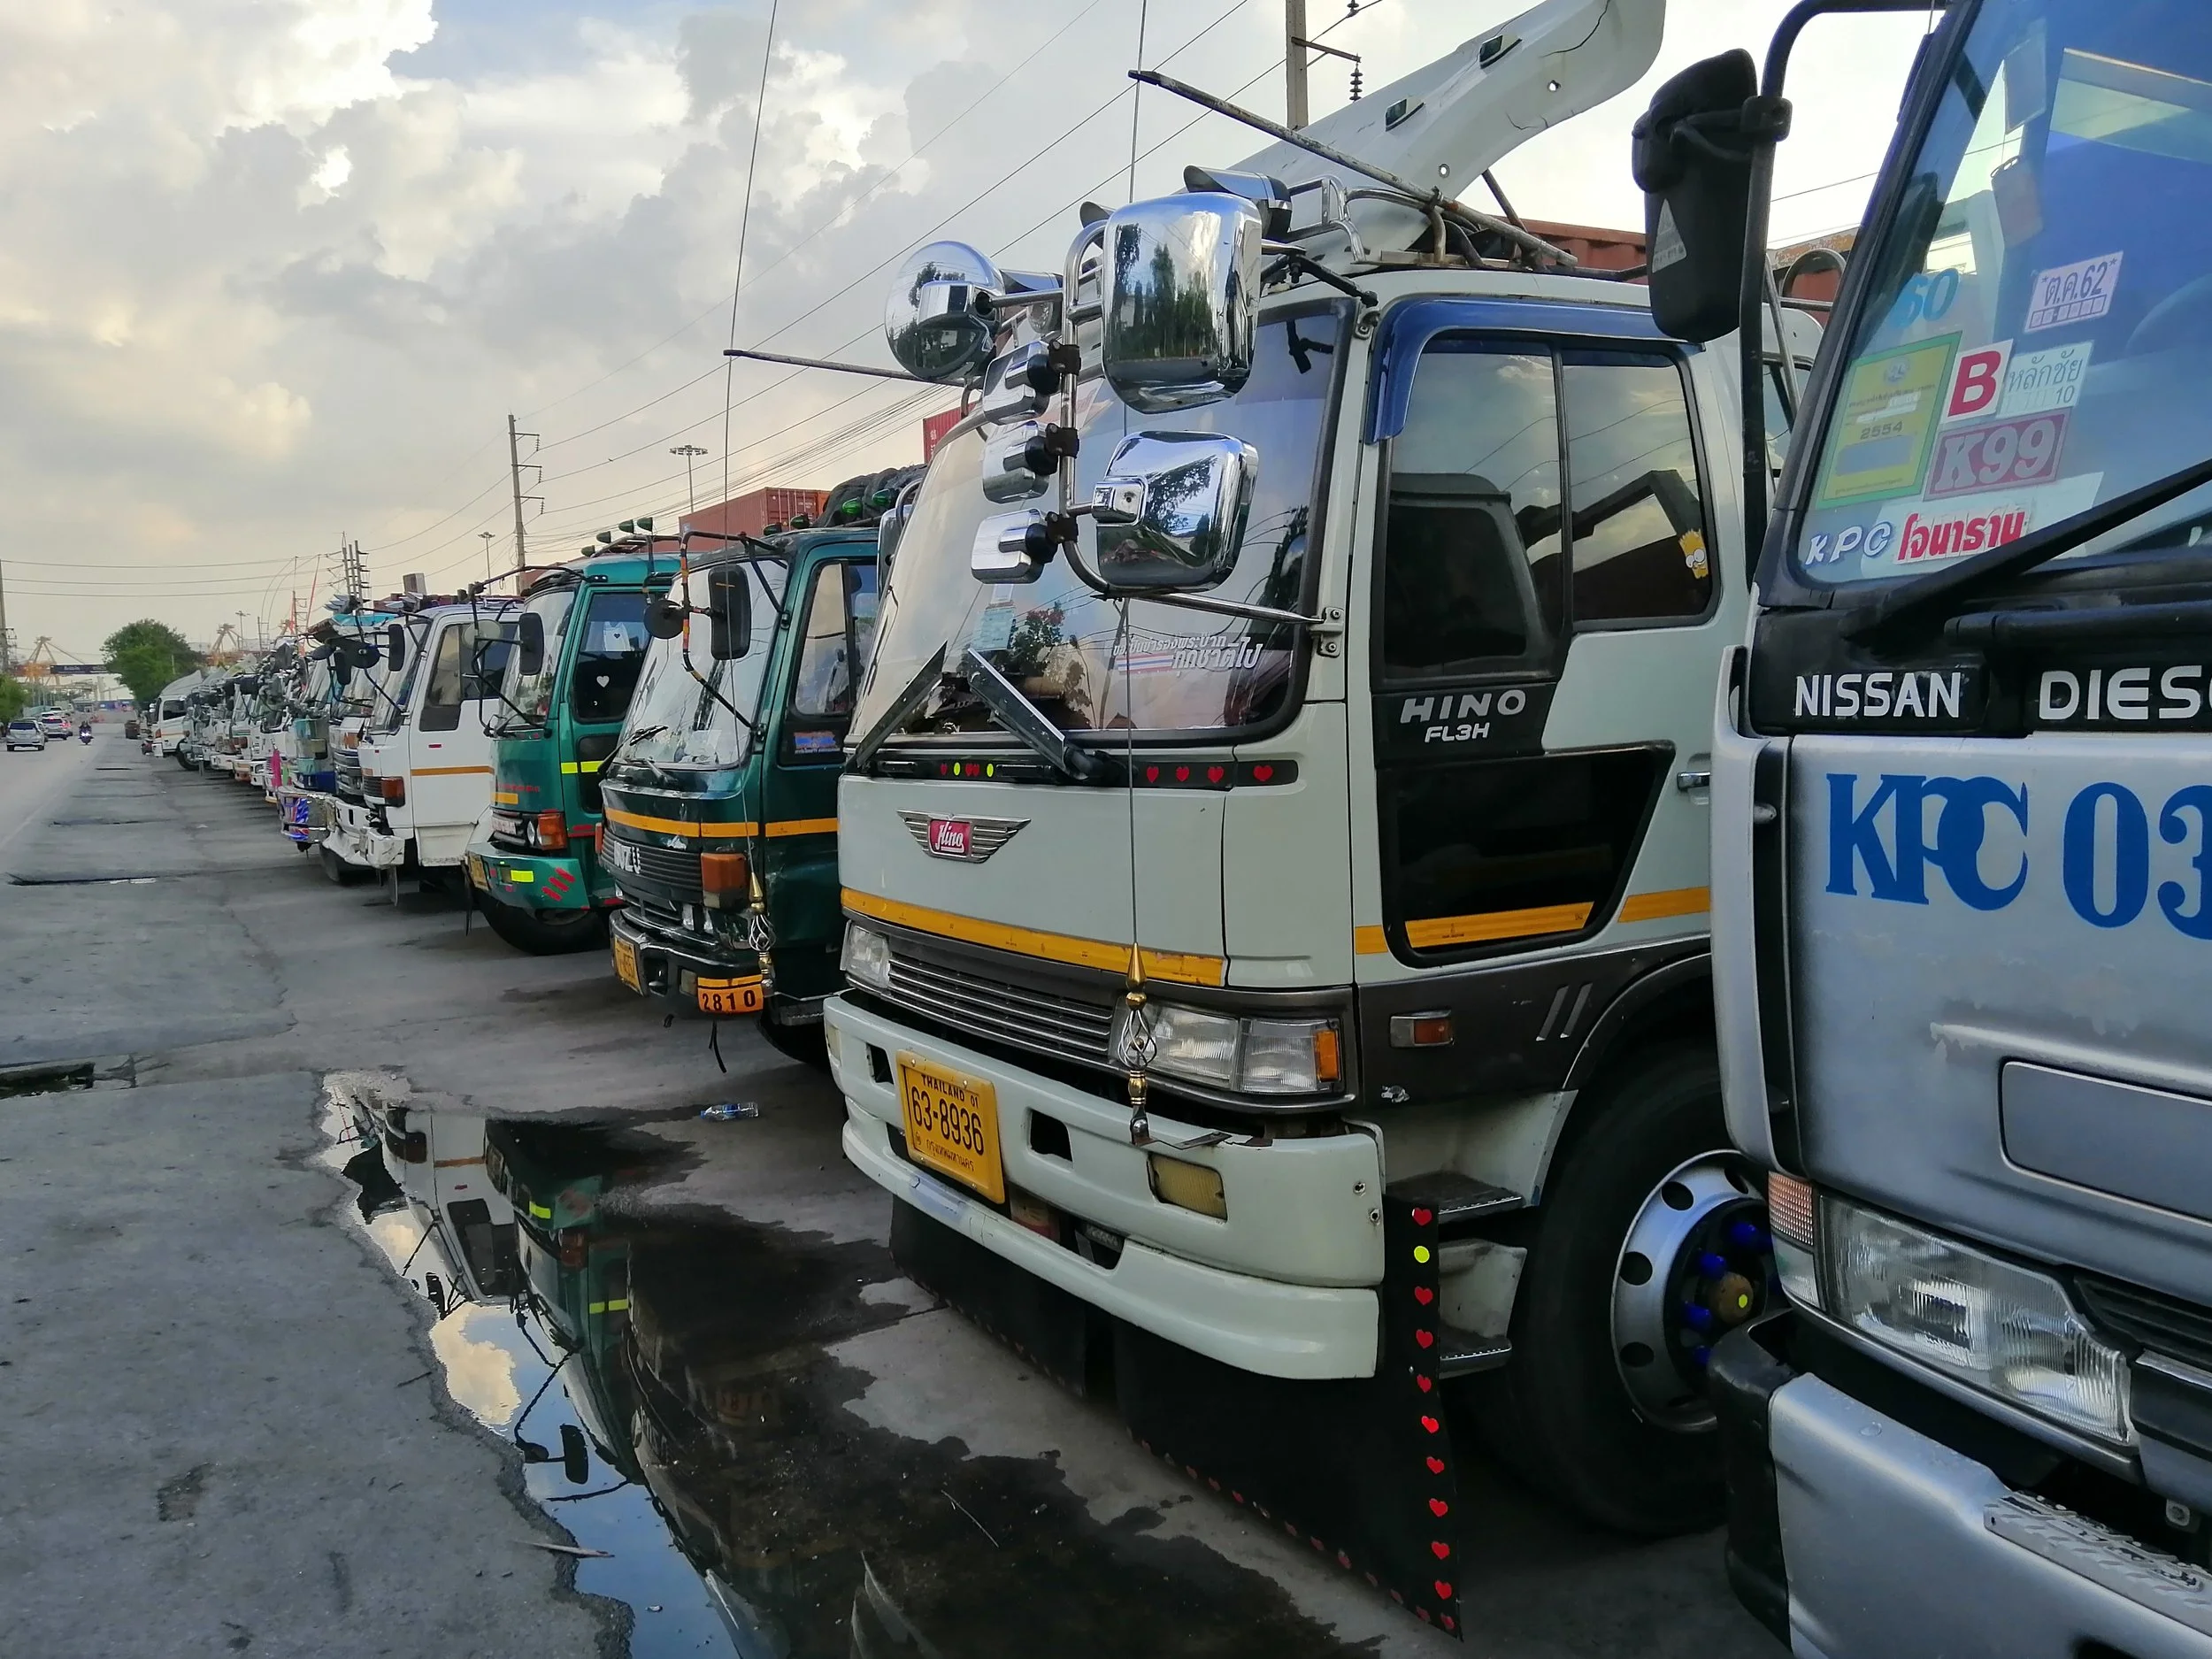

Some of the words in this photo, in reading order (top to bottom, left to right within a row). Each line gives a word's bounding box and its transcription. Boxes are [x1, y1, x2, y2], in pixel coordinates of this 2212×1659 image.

[1947, 350, 2001, 418] B
[2008, 349, 2083, 393] หลักชัย
[2056, 385, 2075, 405] 10
[1860, 420, 1903, 440] 2554
[1935, 419, 2056, 489] K99
[1805, 520, 1894, 566] KPC
[1400, 689, 1526, 724] HINO
[1795, 672, 1961, 718] NISSAN
[2039, 665, 2212, 720] DIES
[1425, 722, 1491, 743] FL3H
[934, 821, 965, 854] Hino
[1825, 772, 2029, 911] KPC
[702, 989, 757, 1012] 2810
[921, 1074, 965, 1102] THAILAND
[911, 1086, 984, 1156] 63-8936
